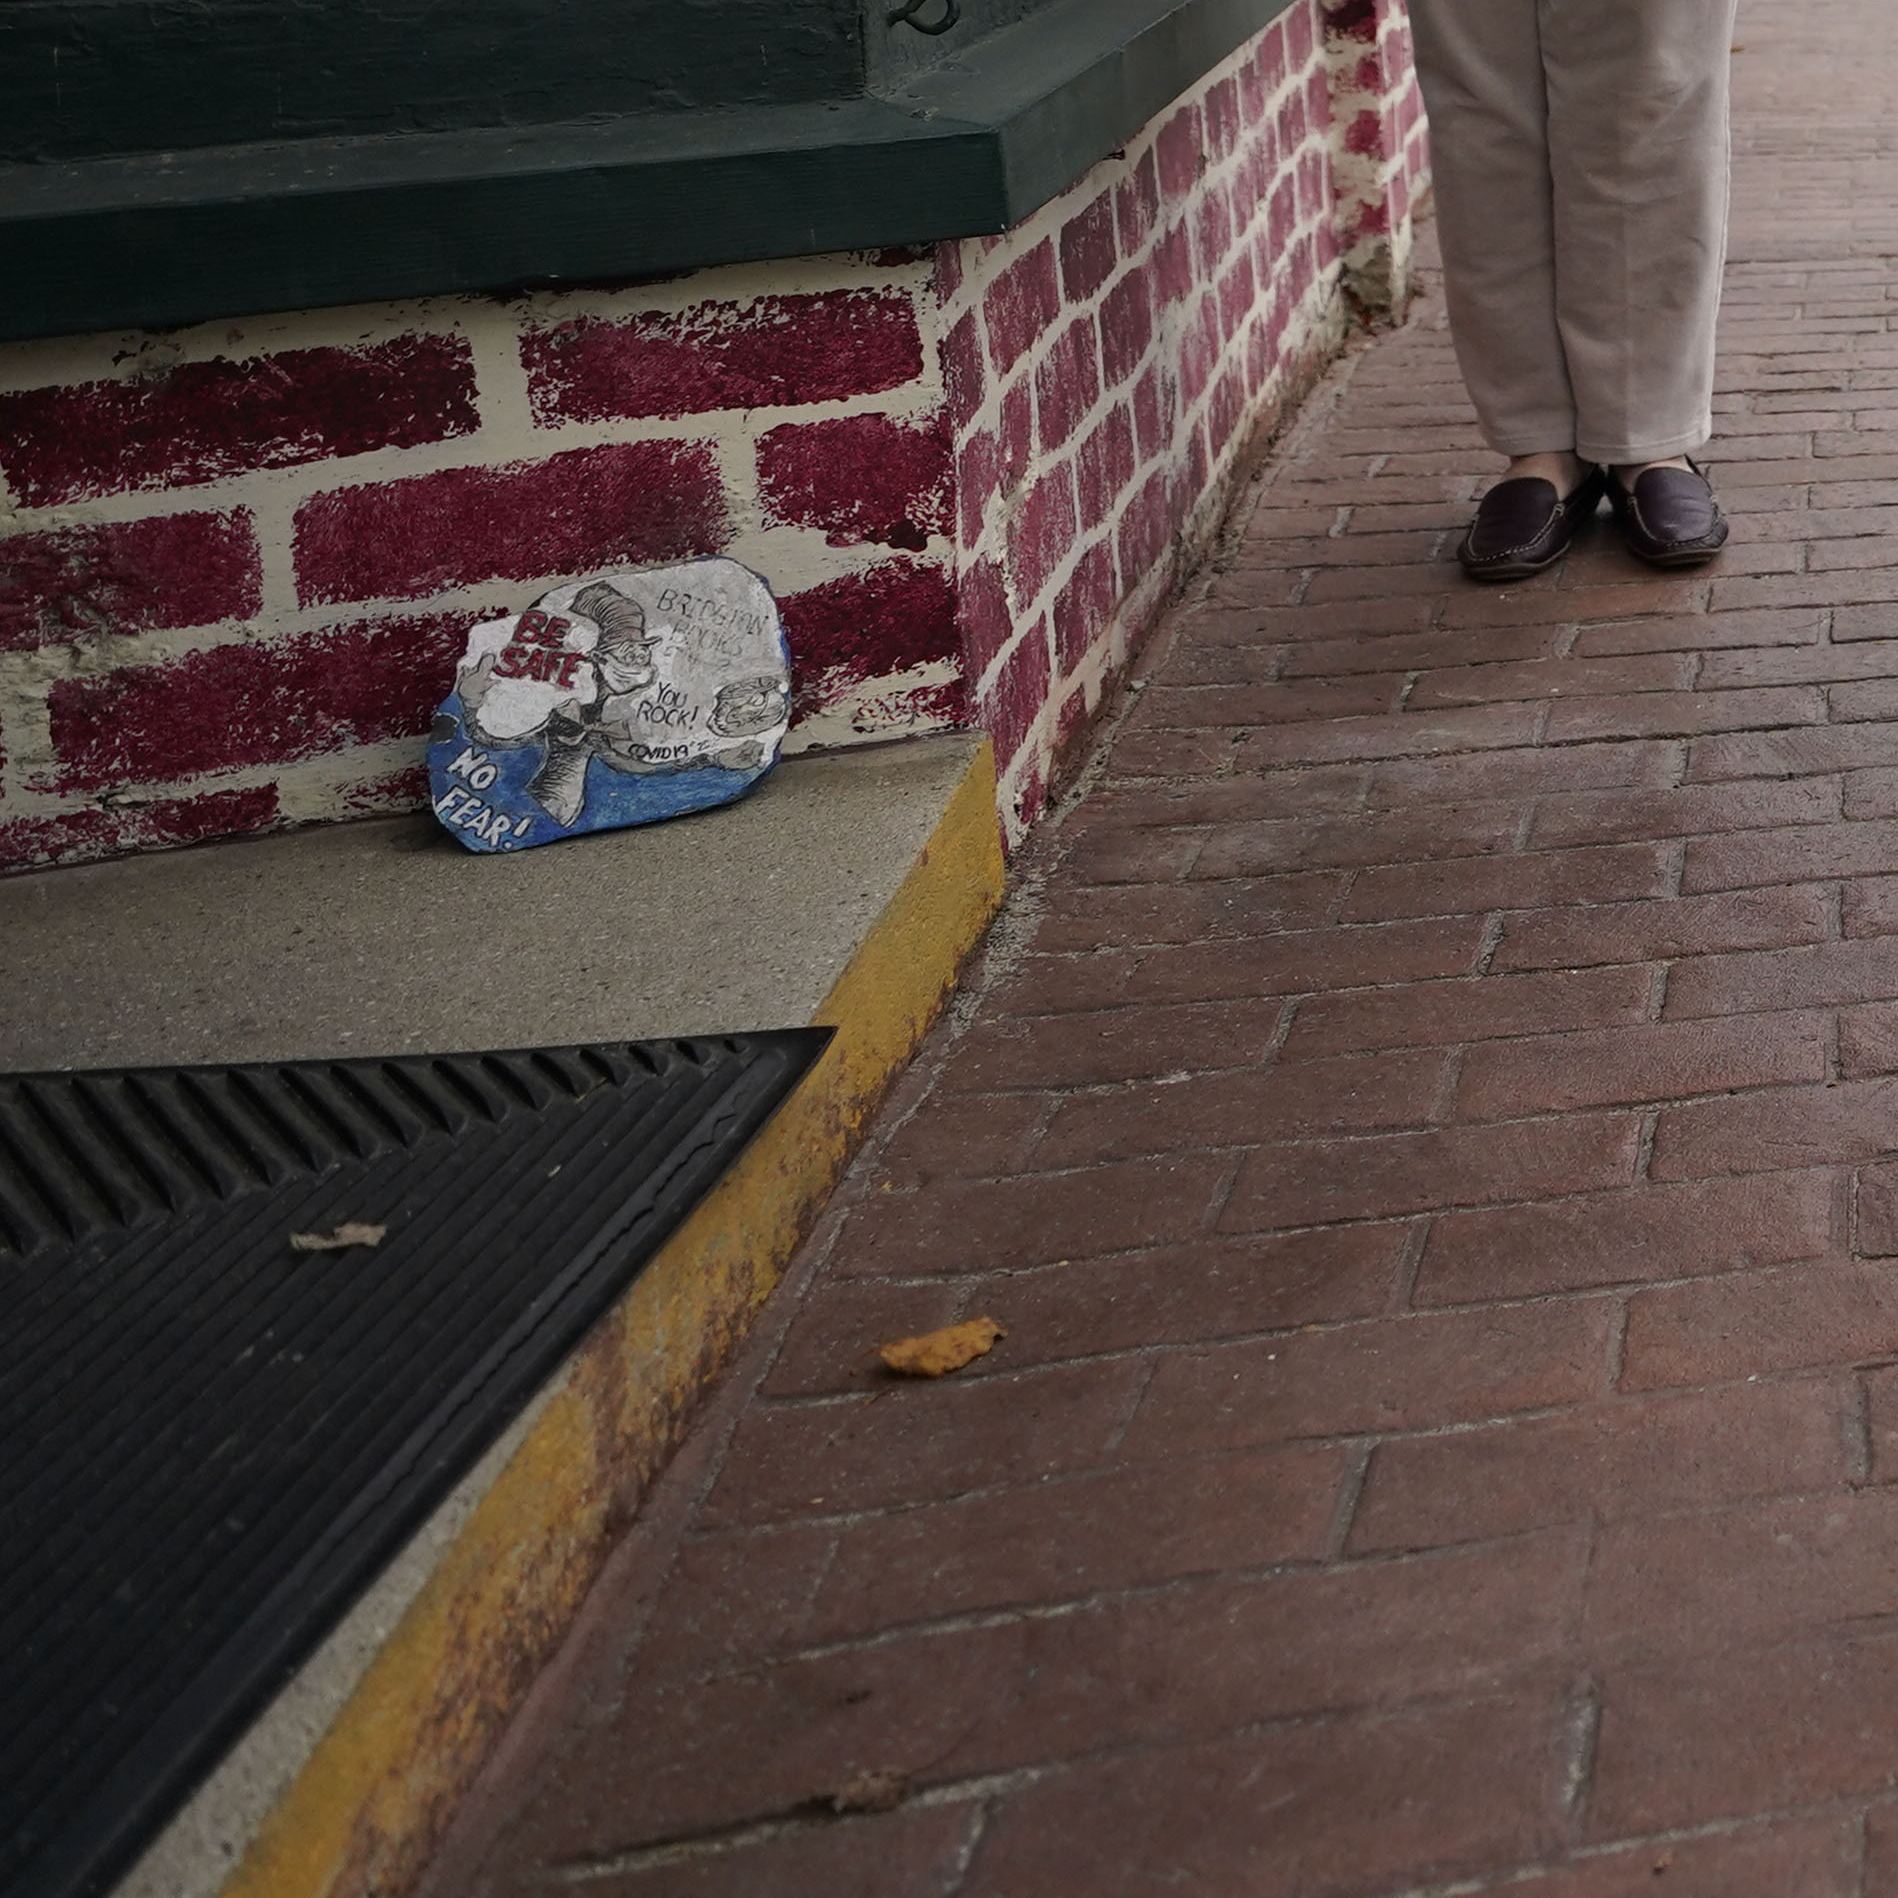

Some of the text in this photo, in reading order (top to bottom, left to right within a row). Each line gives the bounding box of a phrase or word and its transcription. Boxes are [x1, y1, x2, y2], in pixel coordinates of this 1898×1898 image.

[513, 609, 571, 649] BE
[494, 646, 587, 689] SAFE
[636, 699, 700, 731] ROCK!
[657, 681, 688, 709] YOU
[447, 746, 499, 791] NO
[435, 784, 532, 850] FEAR!
